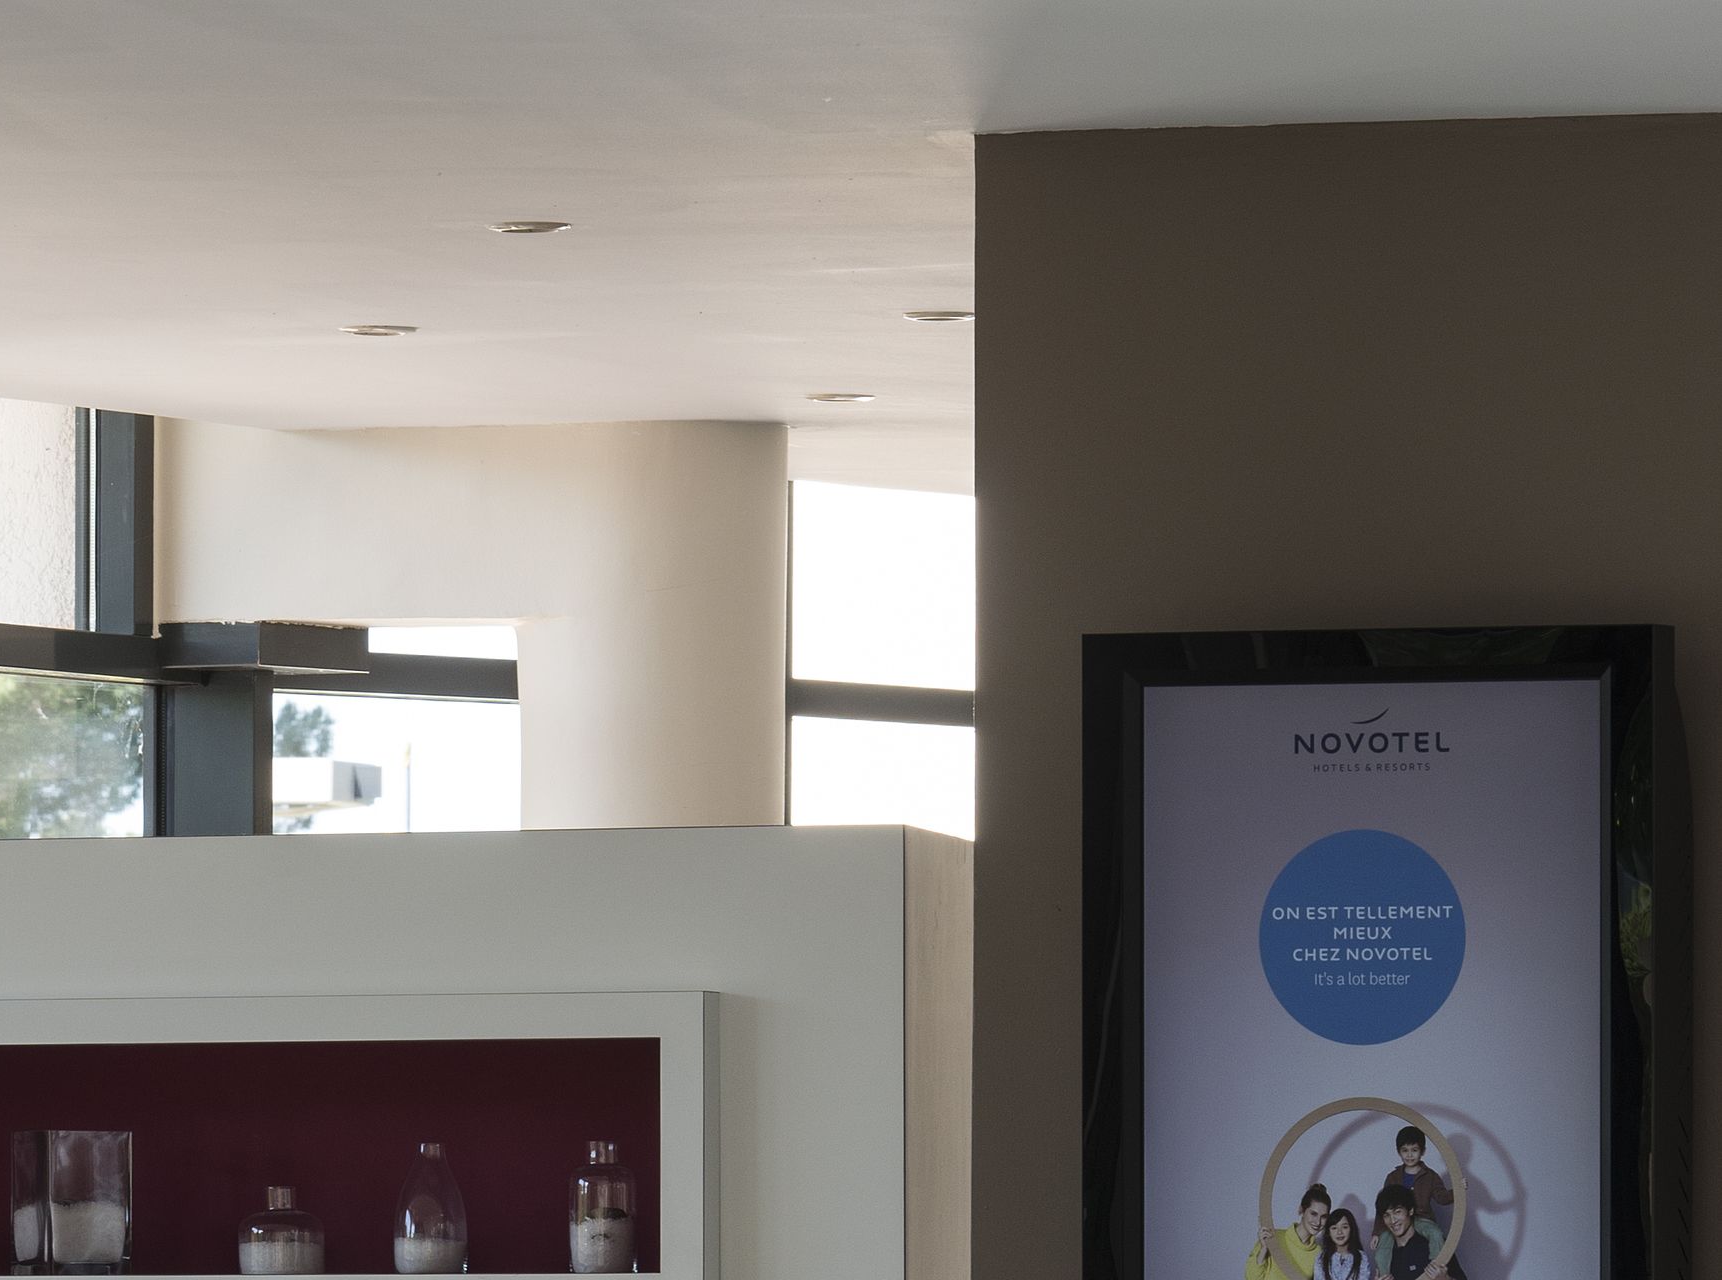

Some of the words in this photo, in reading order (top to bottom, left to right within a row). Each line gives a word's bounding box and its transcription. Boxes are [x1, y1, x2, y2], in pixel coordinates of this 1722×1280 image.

[1294, 732, 1450, 754] NOVOTEL
[1313, 763, 1360, 773] HOTELS
[1365, 763, 1372, 772] &
[1376, 762, 1431, 772] RESORTS
[1272, 906, 1299, 920] ON
[1306, 906, 1338, 920] EST
[1343, 905, 1454, 920] TELLEMENT
[1333, 926, 1392, 940] MIEUX
[1292, 948, 1341, 961] CHEZ
[1346, 947, 1433, 961] NOVOTEL
[1314, 971, 1334, 985] It's
[1337, 974, 1345, 985] a
[1348, 971, 1366, 985] lot
[1369, 971, 1410, 985] better
